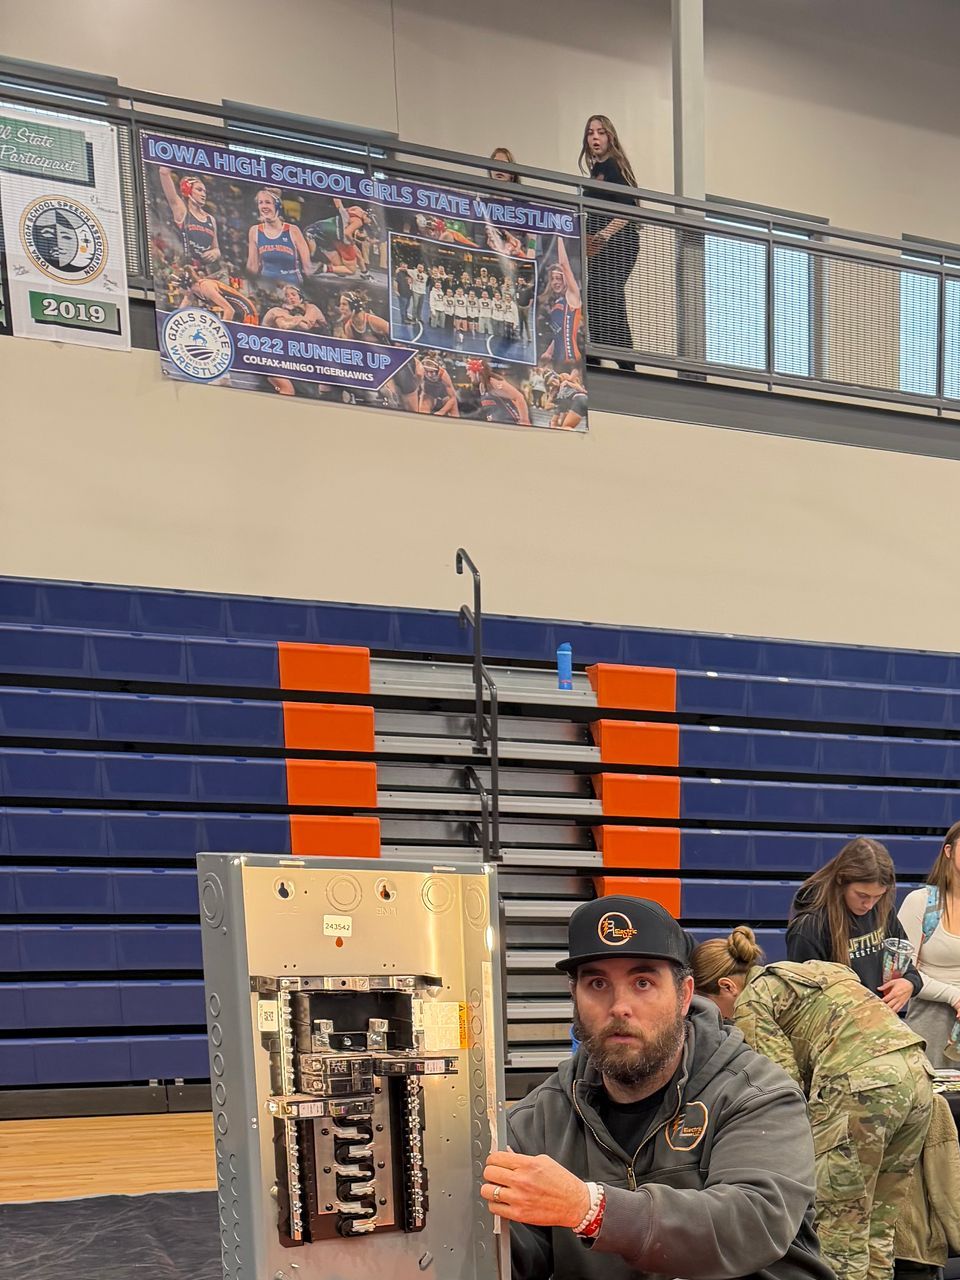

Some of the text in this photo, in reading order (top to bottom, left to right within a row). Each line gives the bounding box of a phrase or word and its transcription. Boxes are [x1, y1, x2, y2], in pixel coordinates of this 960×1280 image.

[0, 125, 55, 148] ll State
[0, 145, 81, 173] Participant
[148, 139, 574, 232] IOWA HIGH SCHOOL GIRLS STATE WRESTLING
[27, 201, 55, 223] SCHOOL
[57, 201, 91, 223] SPEECH
[25, 224, 34, 247] HIGH
[31, 249, 50, 270] IOWA
[84, 224, 103, 276] ASSOCIATION
[42, 298, 106, 323] 2019
[168, 312, 230, 349] GIRLS STATE
[170, 345, 230, 377] WRESTLING
[236, 332, 392, 370] 2022 RUNNER UP
[243, 354, 374, 382] COLFAX-MINGO TIGERHAWKS
[325, 922, 351, 931] 243542
